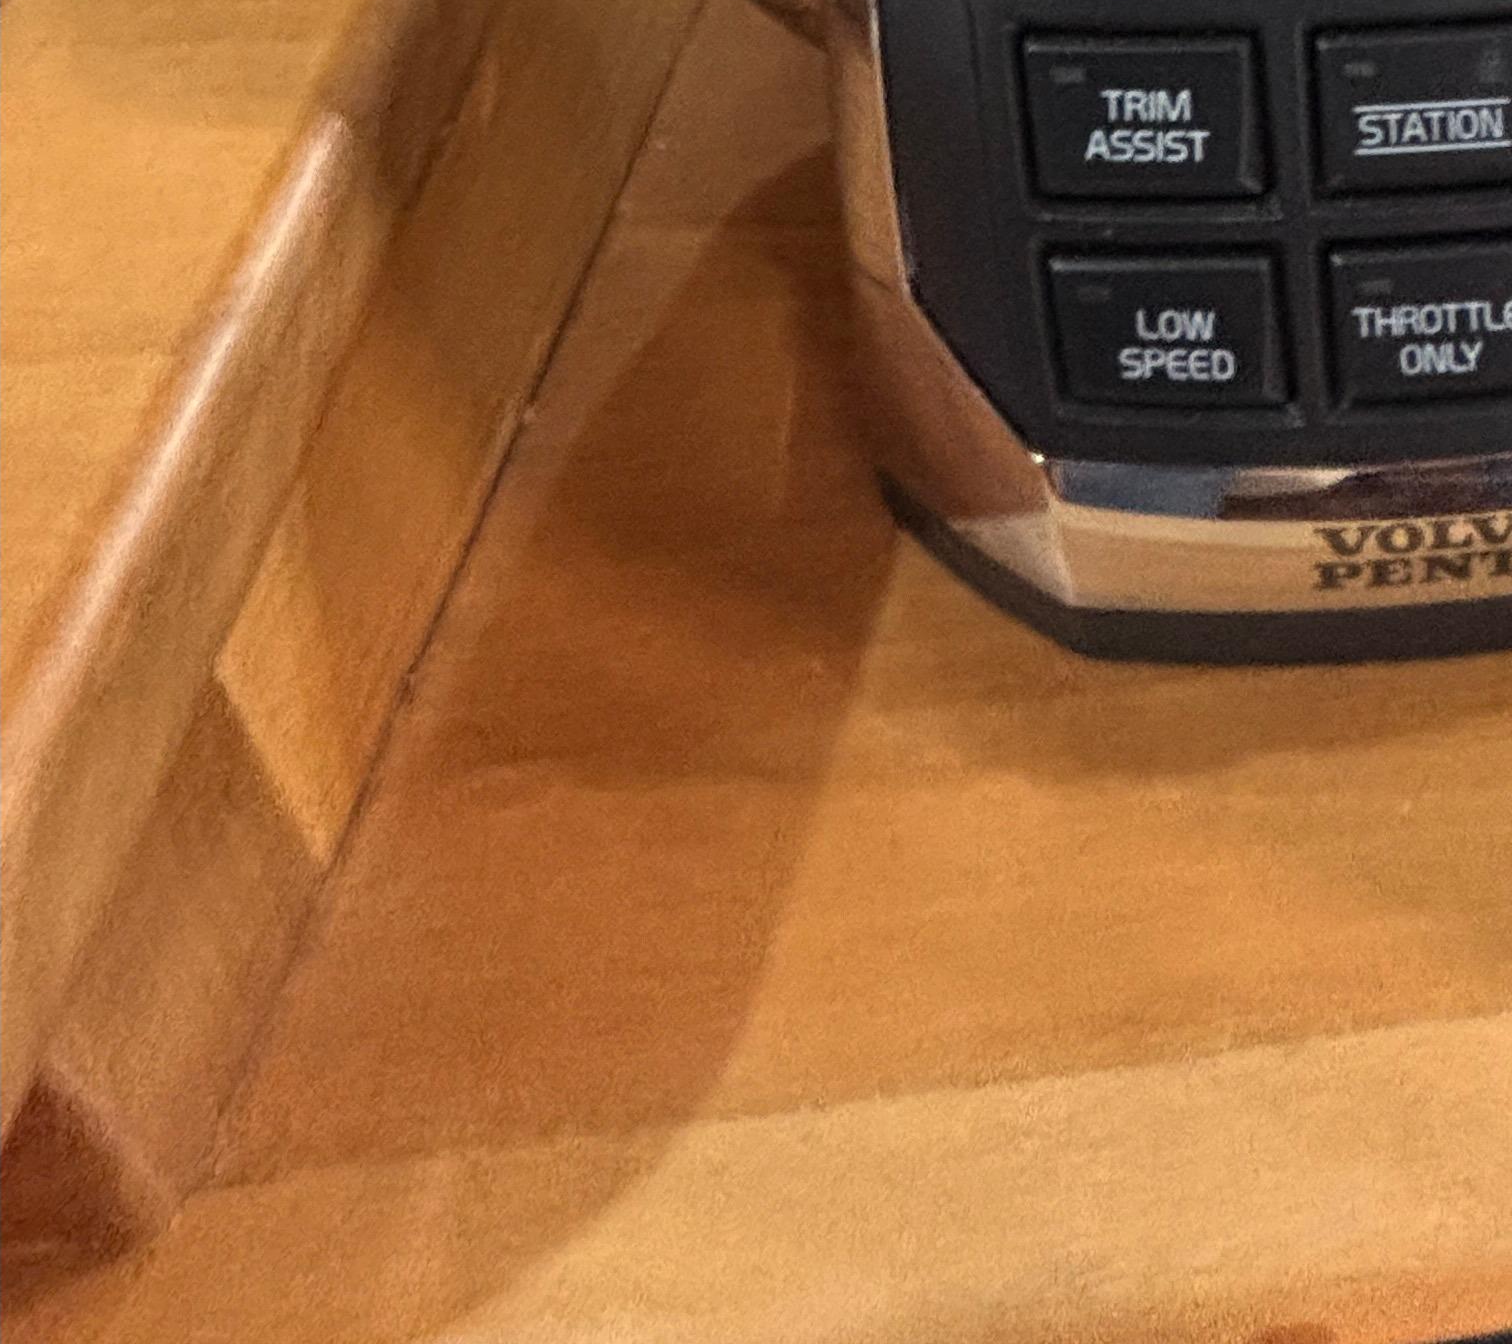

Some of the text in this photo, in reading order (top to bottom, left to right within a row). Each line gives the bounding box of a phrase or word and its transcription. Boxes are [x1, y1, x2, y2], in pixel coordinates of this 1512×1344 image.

[1100, 88, 1192, 123] TRIM
[1357, 106, 1505, 147] STATION
[1085, 129, 1210, 163] ASSIST
[1135, 309, 1216, 342] LOW
[1118, 347, 1236, 381] SPEED
[1399, 340, 1484, 376] ONLY
